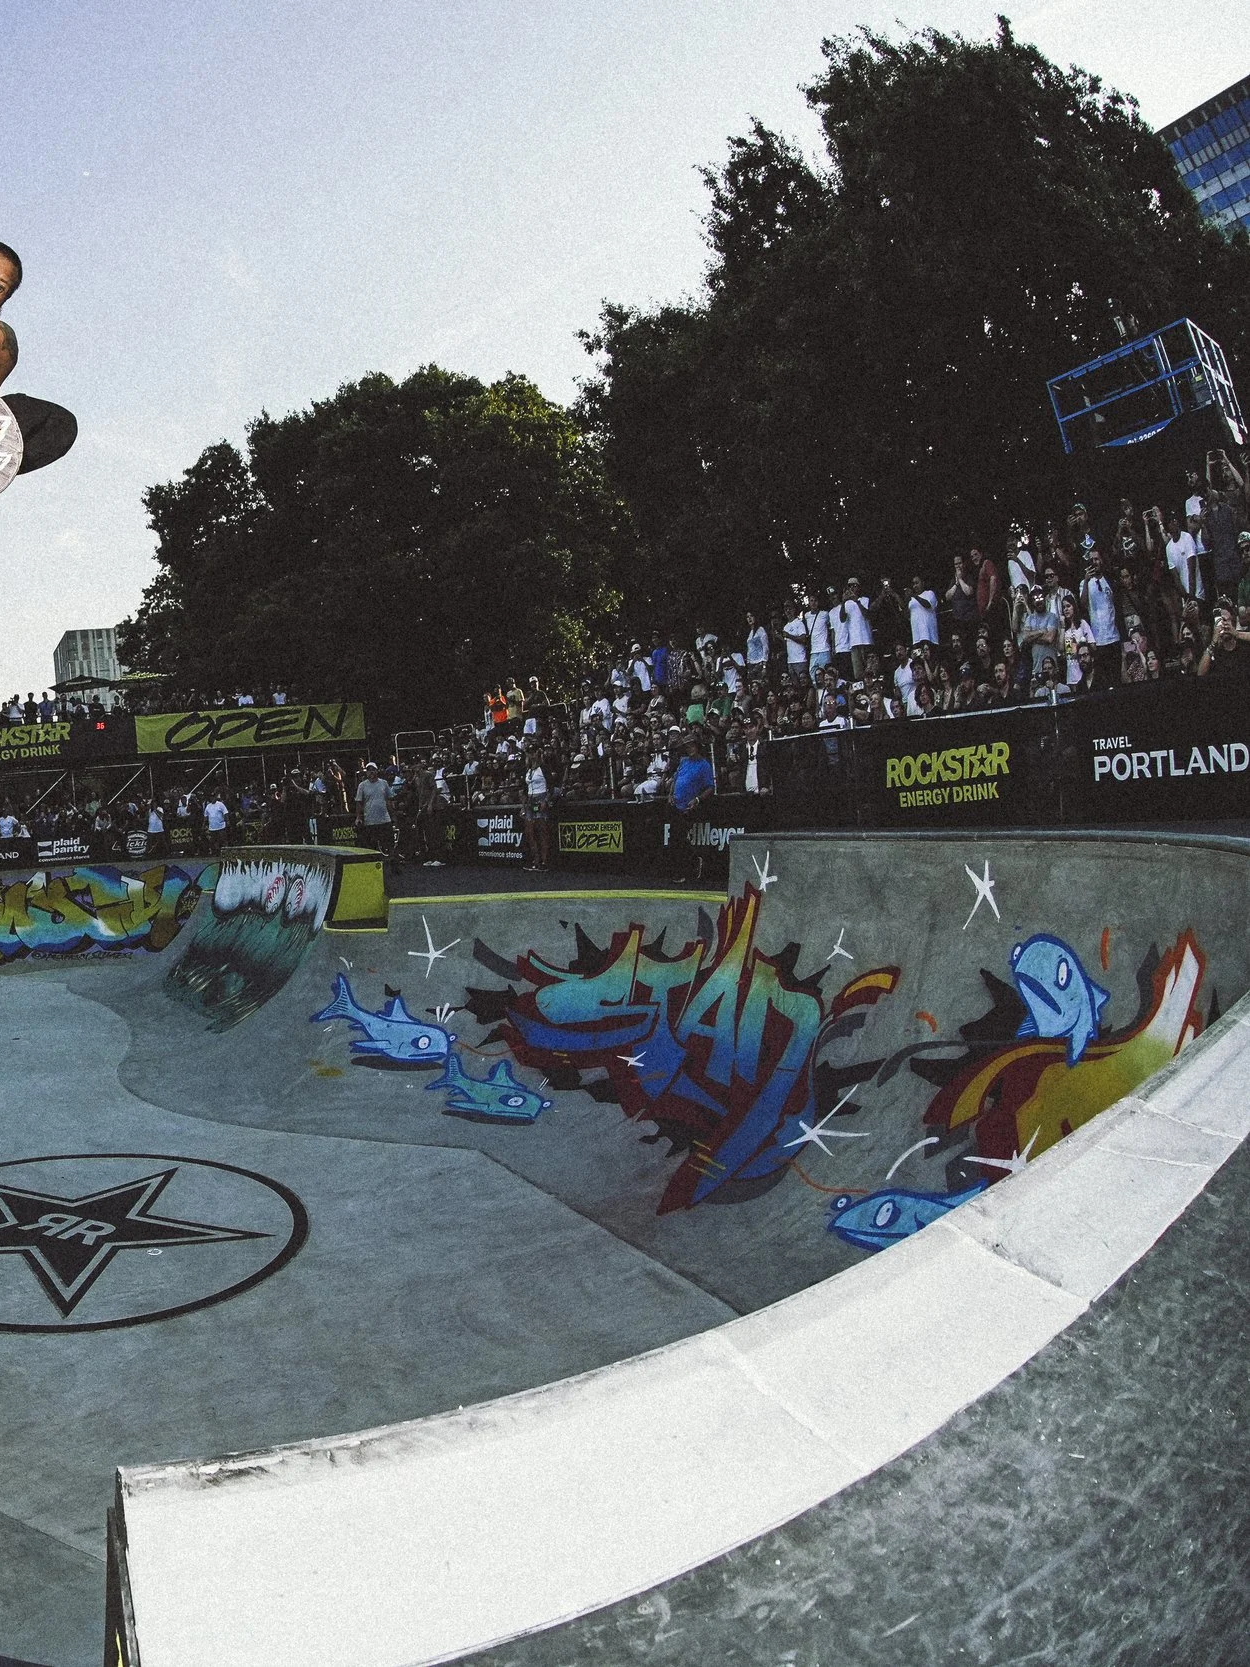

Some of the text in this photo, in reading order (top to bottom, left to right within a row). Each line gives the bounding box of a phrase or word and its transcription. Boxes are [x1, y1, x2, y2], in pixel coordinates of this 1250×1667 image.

[164, 703, 348, 751] OPEN
[20, 744, 61, 758] DRINK
[1093, 736, 1132, 750] TRAVEL
[886, 741, 1010, 788] ROCKSTAR
[1094, 742, 1249, 782] PORTLAND
[899, 782, 999, 808] ENERGY DRINK
[489, 814, 513, 831] plaid
[53, 837, 80, 848] plaid
[488, 831, 523, 847] pantry
[577, 832, 622, 849] OPEN
[53, 844, 90, 856] pantry
[506, 851, 523, 859] stores
